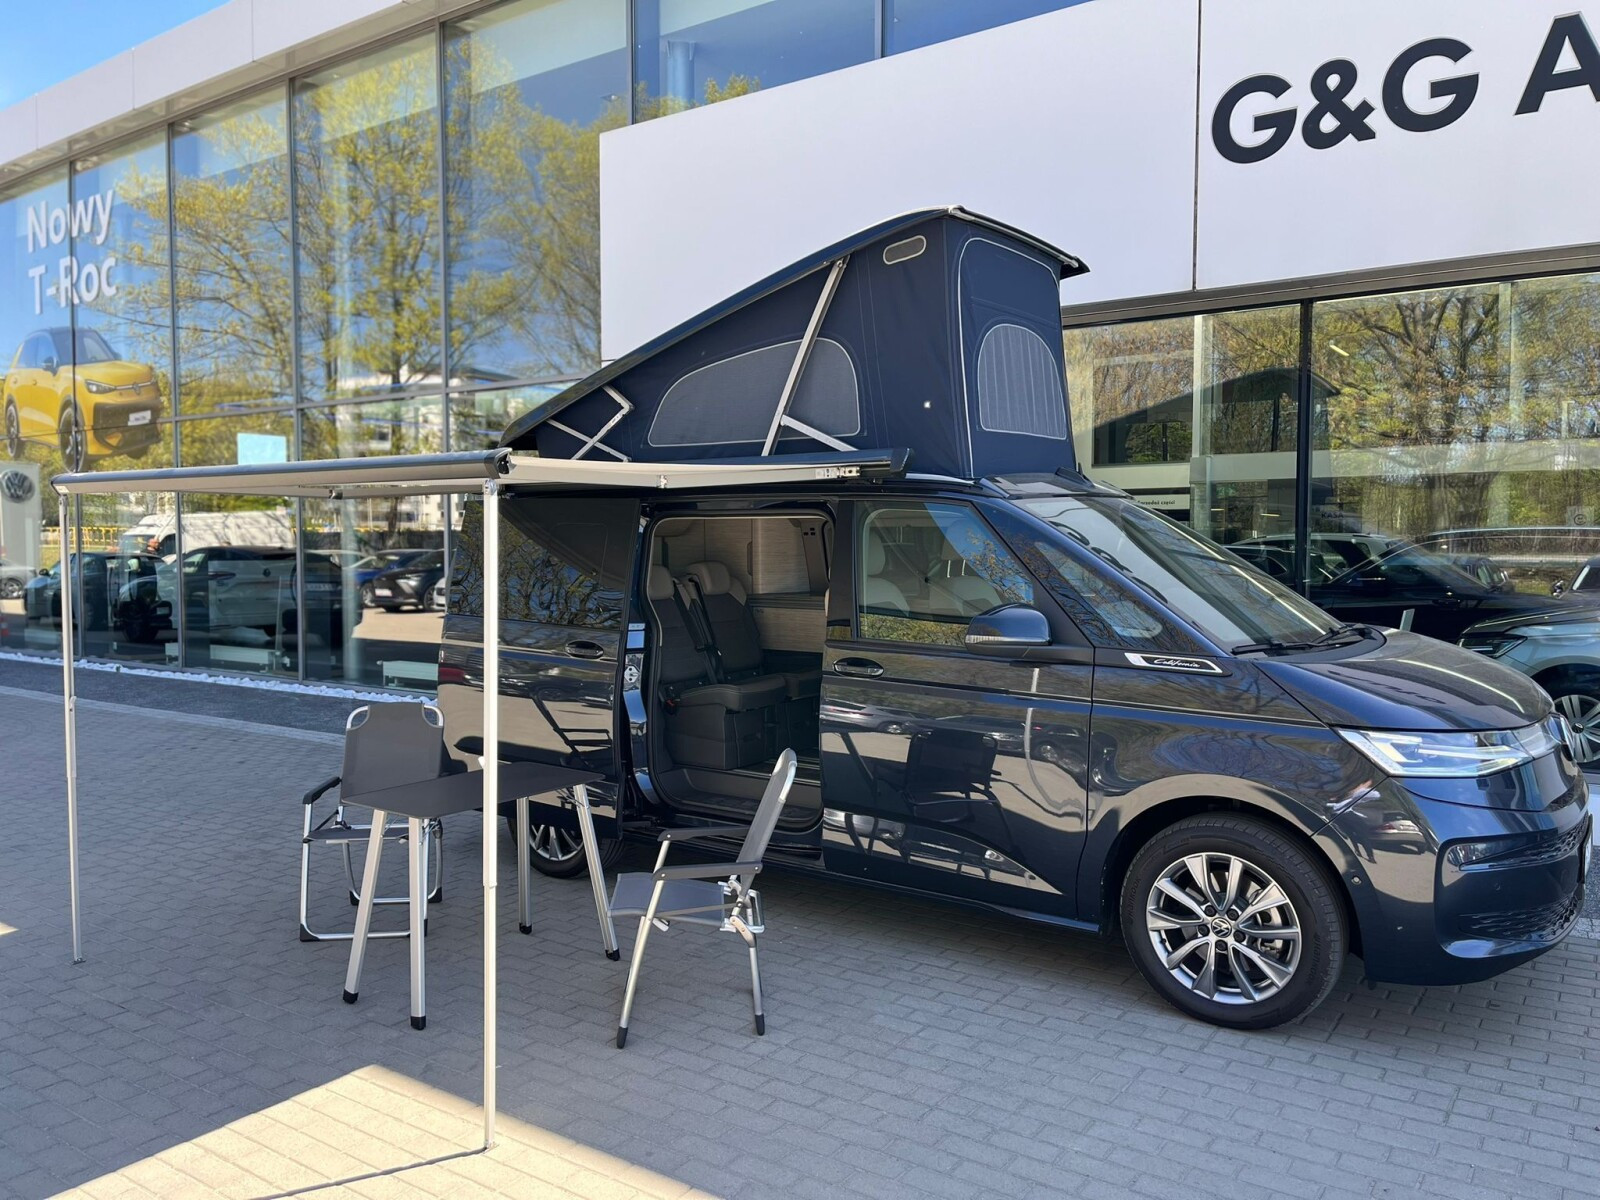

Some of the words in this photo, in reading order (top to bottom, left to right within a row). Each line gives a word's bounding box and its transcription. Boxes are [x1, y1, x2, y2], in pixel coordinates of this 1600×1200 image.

[1211, 36, 1479, 164] G&G
[1513, 11, 1600, 116] A
[27, 190, 113, 252] Nowy
[28, 255, 117, 315] T-Roc
[1153, 658, 1201, 668] California
